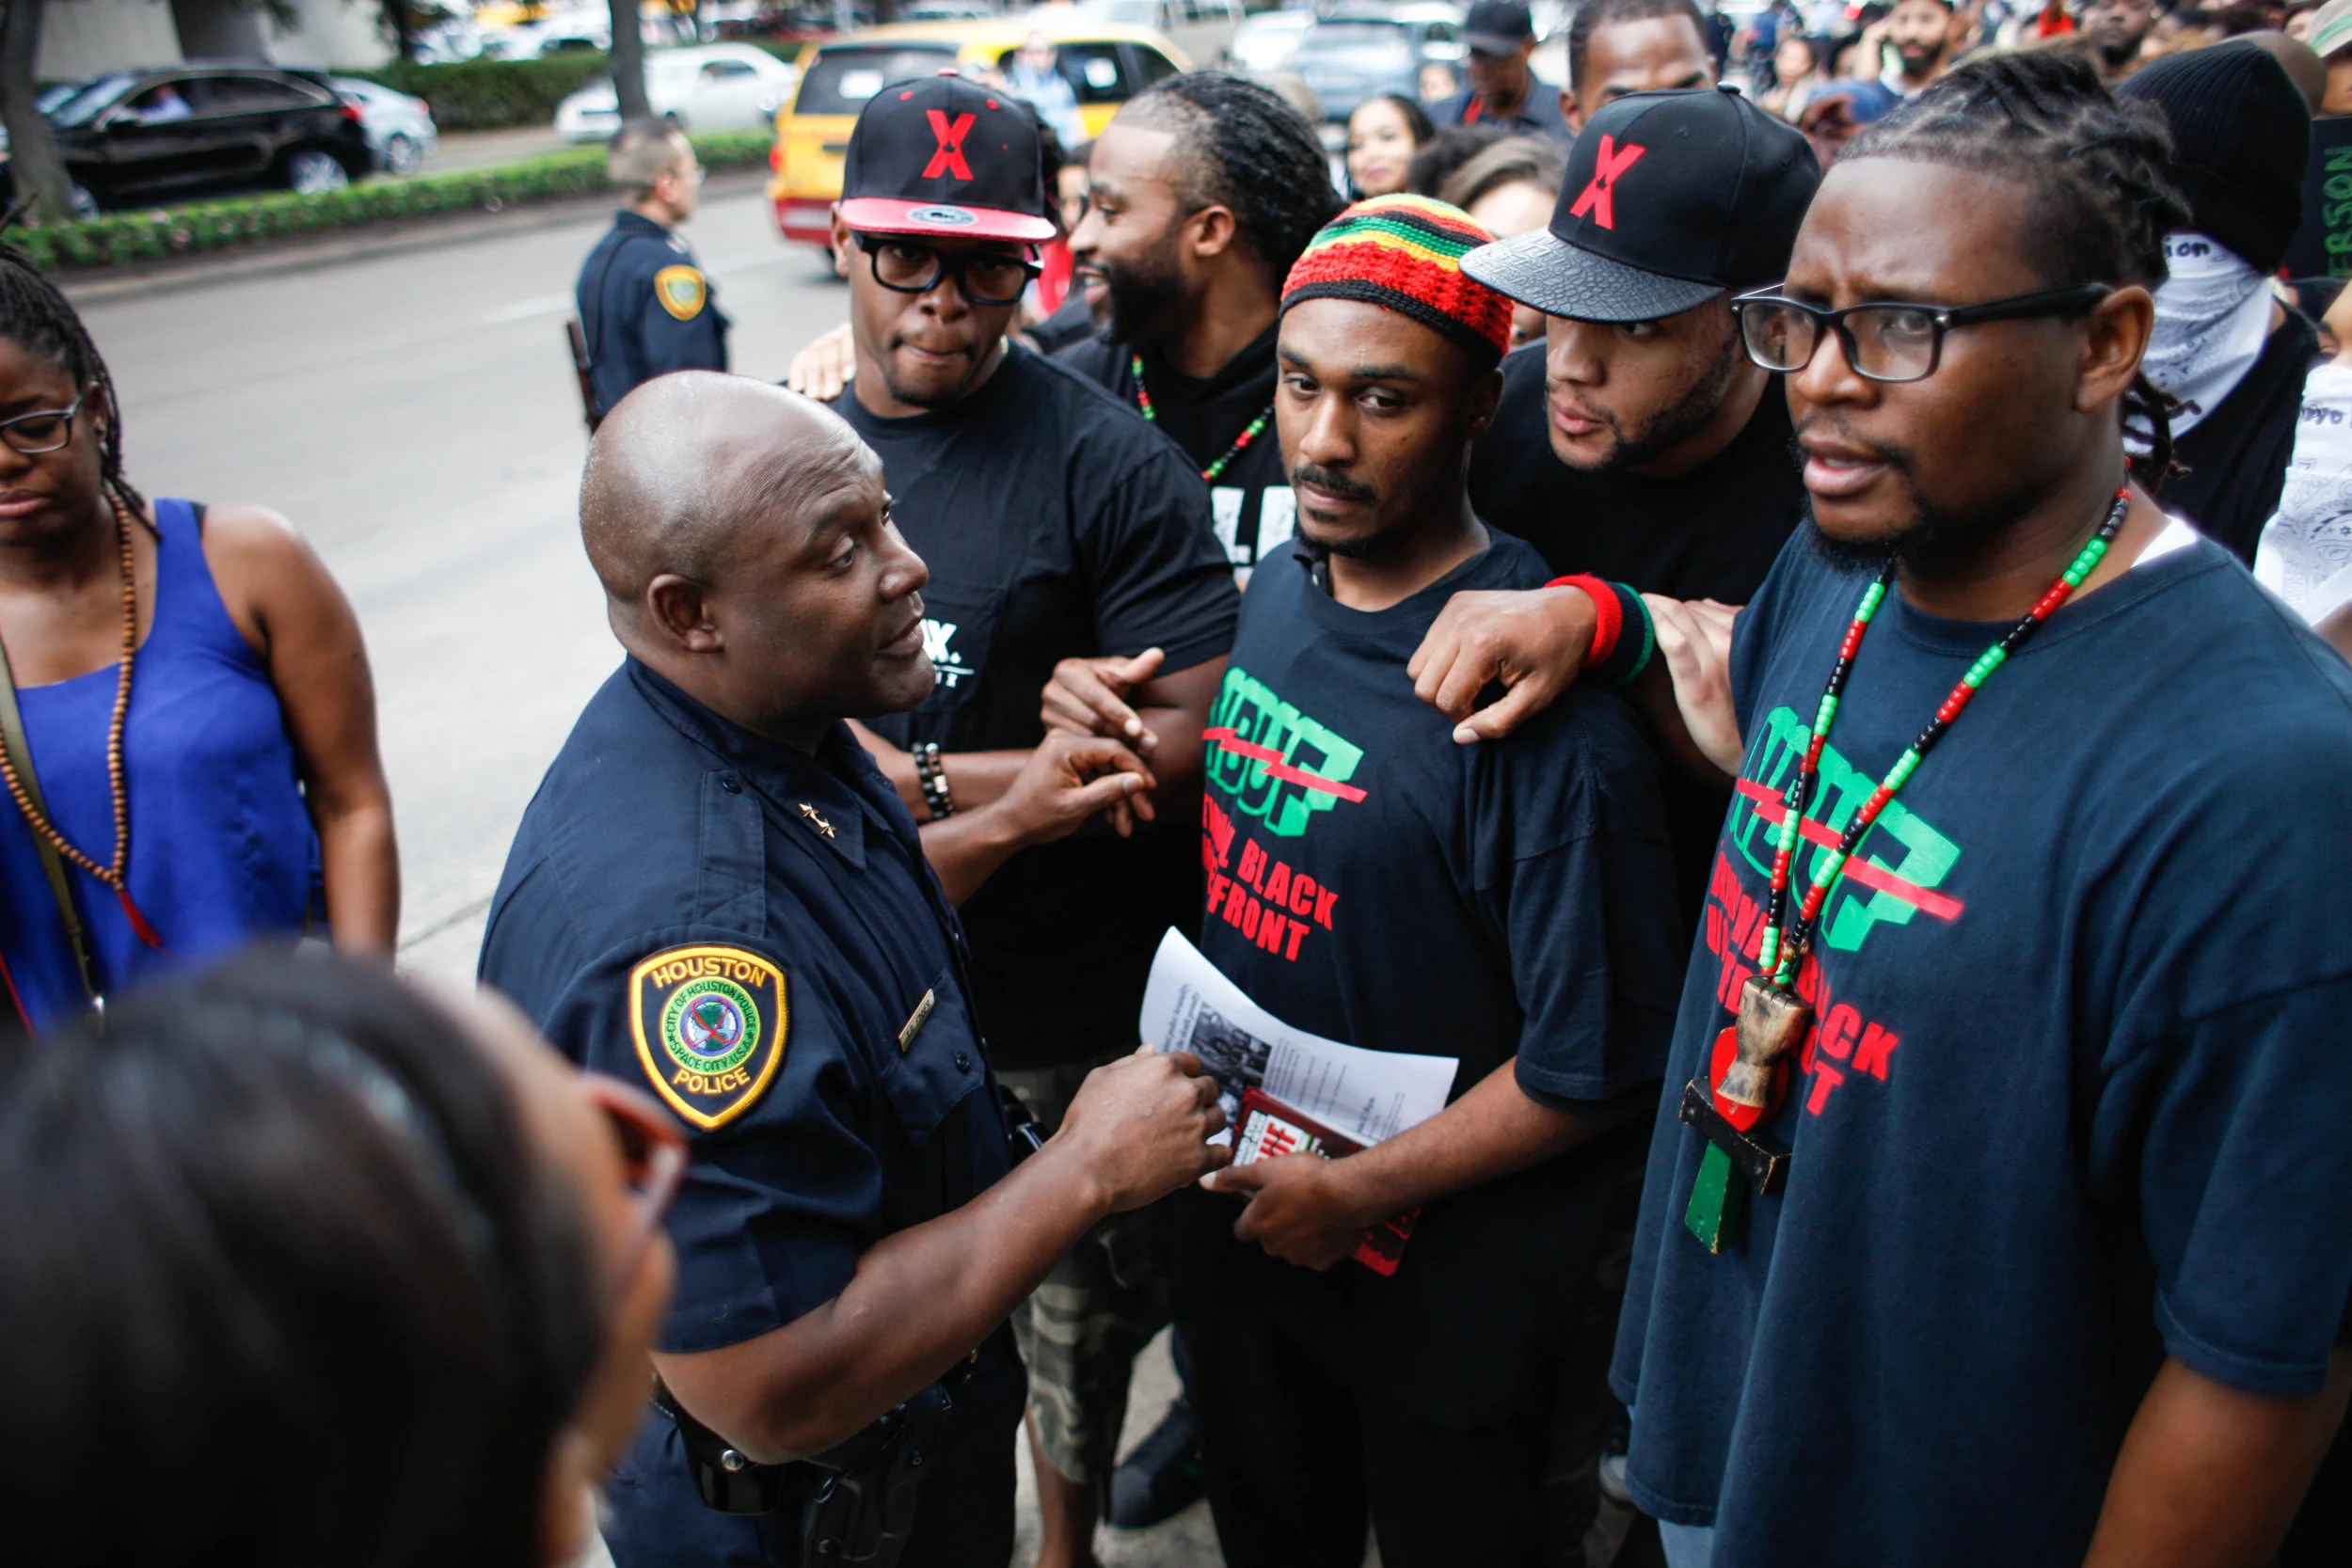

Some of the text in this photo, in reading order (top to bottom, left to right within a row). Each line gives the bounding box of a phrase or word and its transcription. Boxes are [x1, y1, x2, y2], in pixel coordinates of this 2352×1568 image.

[922, 108, 977, 181] X
[1569, 134, 1645, 230] X
[1237, 837, 1339, 930] BLACK
[1207, 873, 1311, 962] FRONT
[652, 957, 768, 989] HOUSTON
[666, 980, 756, 1032] CITY OF HOUSTON POLICE
[670, 1041, 702, 1069] SPACE
[703, 1057, 728, 1072] CITY
[674, 1067, 751, 1093] POLICE
